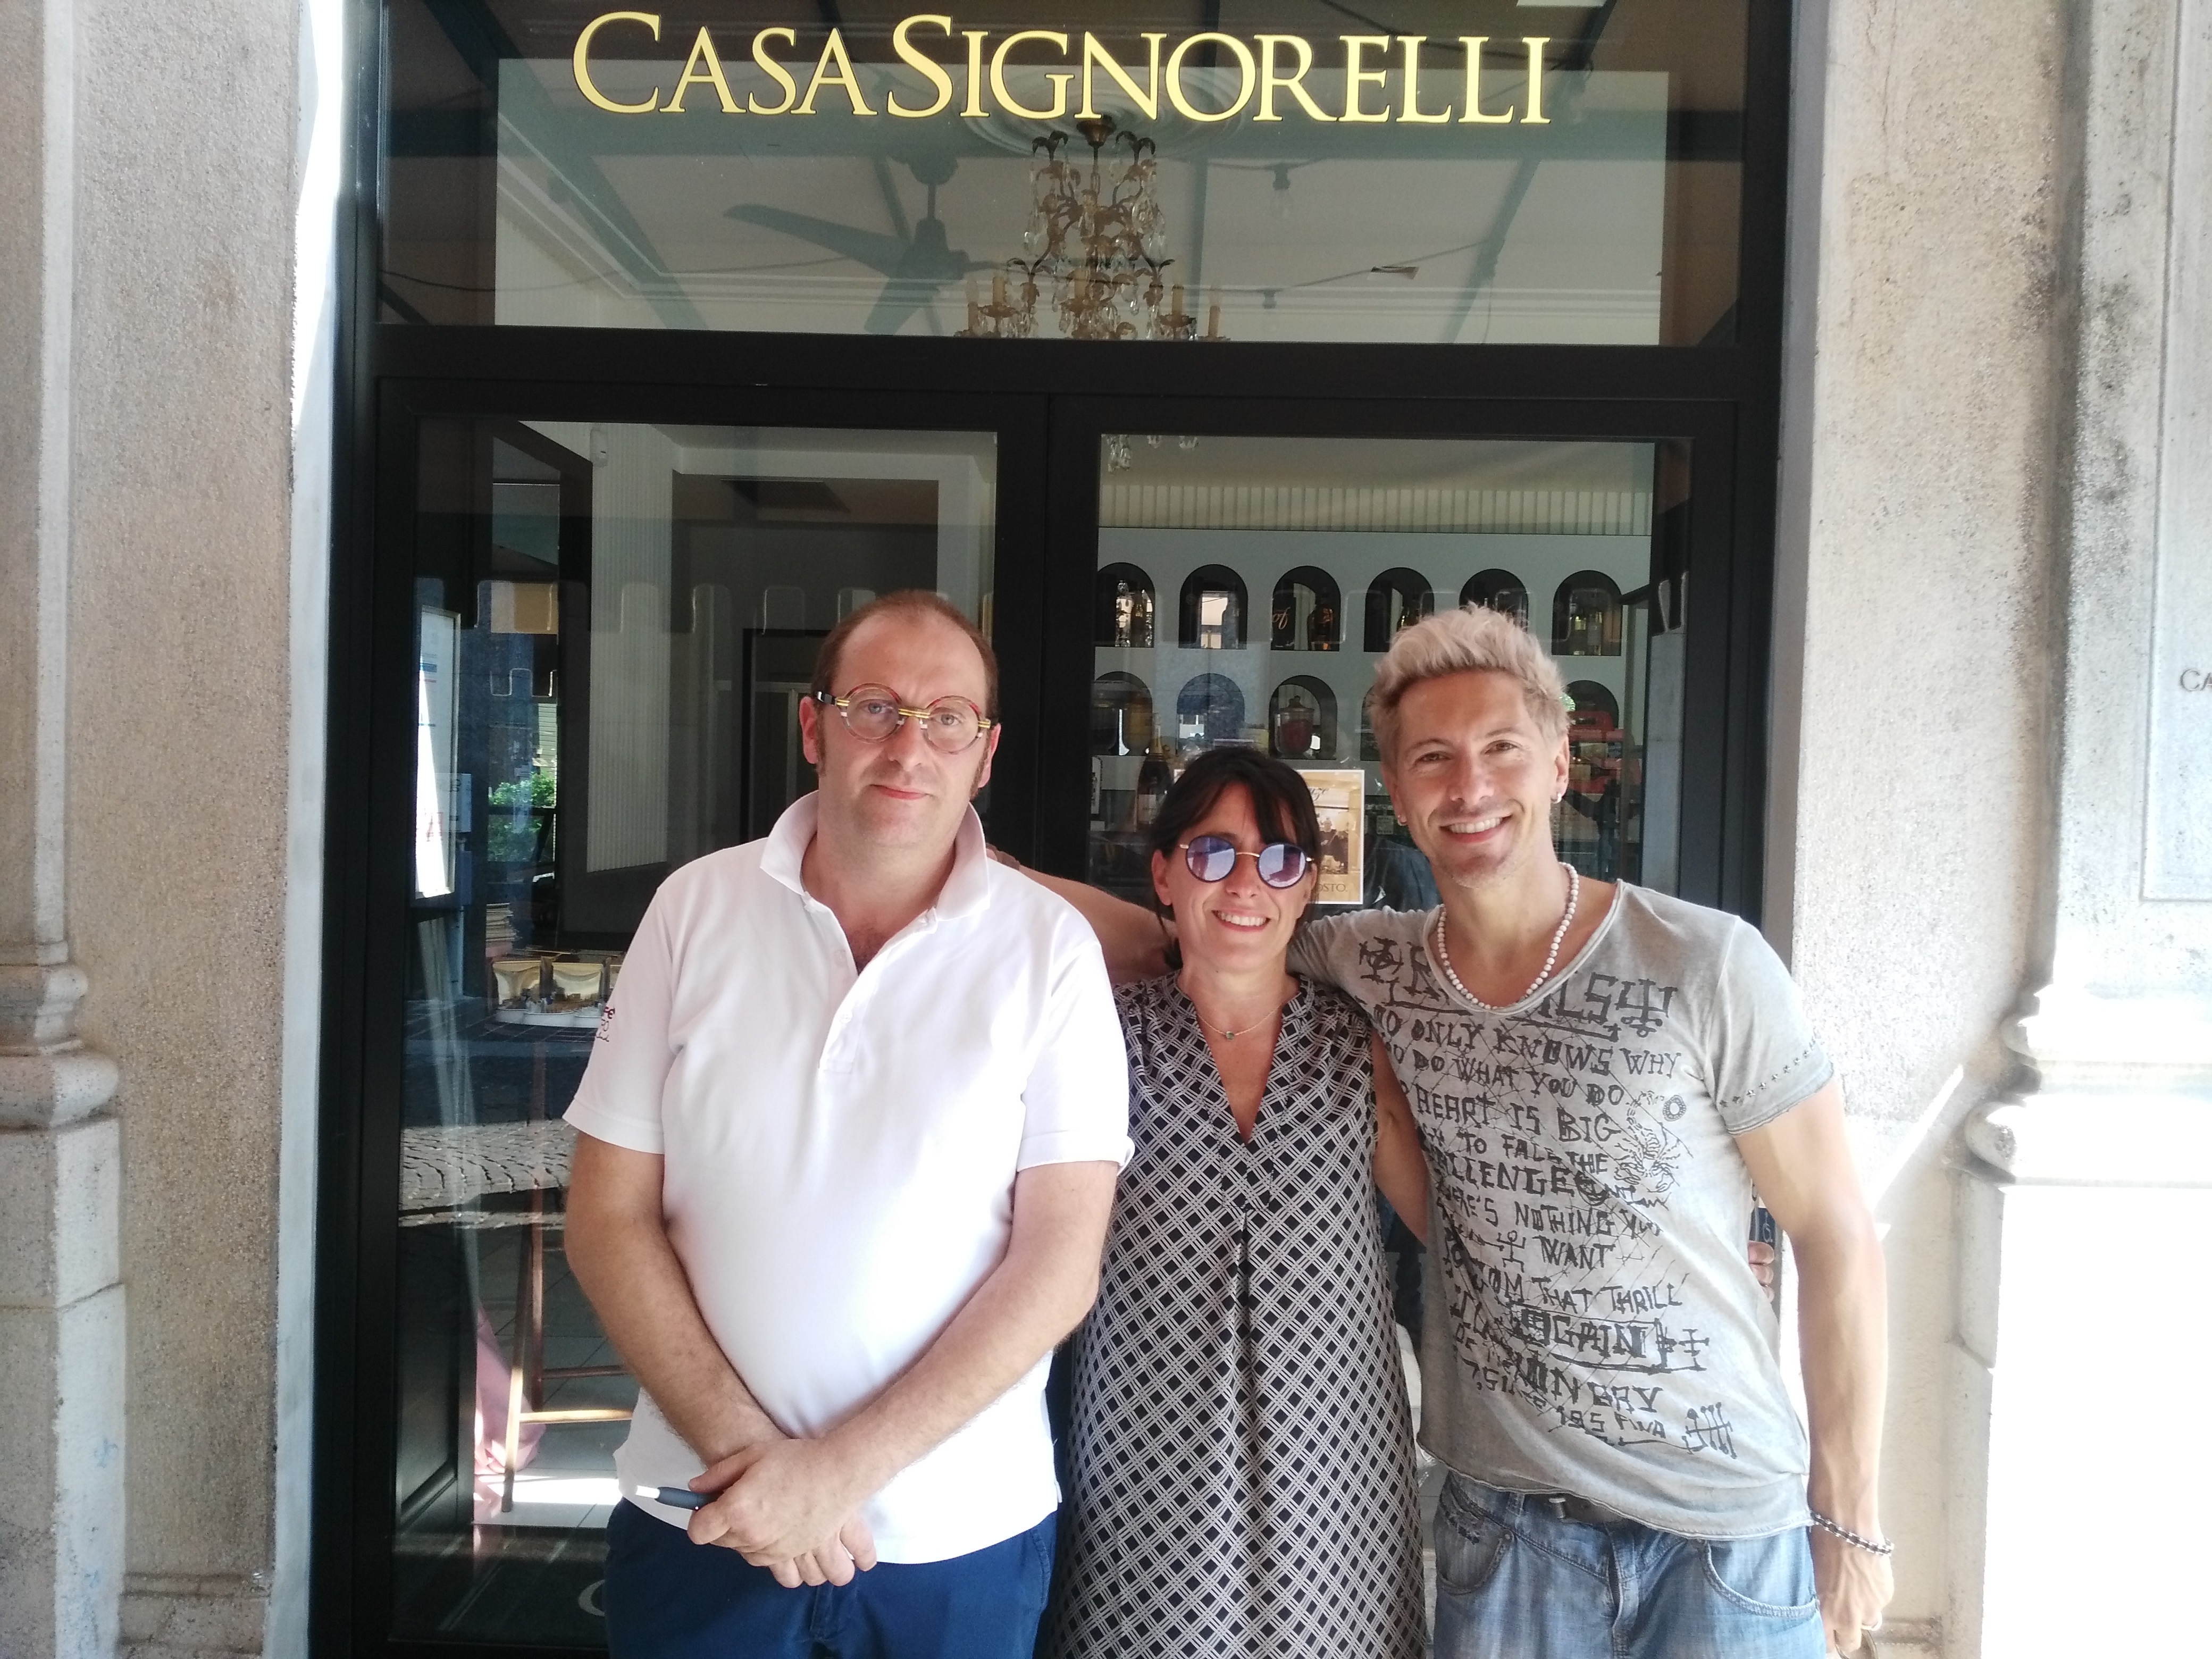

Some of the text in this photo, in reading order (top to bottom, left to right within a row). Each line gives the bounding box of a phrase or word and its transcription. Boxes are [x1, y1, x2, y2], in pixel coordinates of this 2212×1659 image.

[572, 10, 1551, 124] CASA SIGNORELLI
[1411, 1019, 1485, 1051] ONLY
[1492, 1027, 1614, 1076] KNOWS
[1619, 1048, 1682, 1079] WHY
[1452, 1058, 1520, 1089] WHAT
[1585, 1083, 1624, 1108] DO
[1414, 1083, 1496, 1129] HEART
[1510, 1102, 1541, 1136] IS
[1557, 1107, 1622, 1143] BIG
[1456, 1130, 1487, 1155] TO
[1564, 1151, 1609, 1175] THE
[1514, 1200, 1615, 1238] NOTHING
[1532, 1235, 1615, 1271] WANT
[1530, 1277, 1593, 1314] THAT
[1601, 1283, 1682, 1314] THRILL
